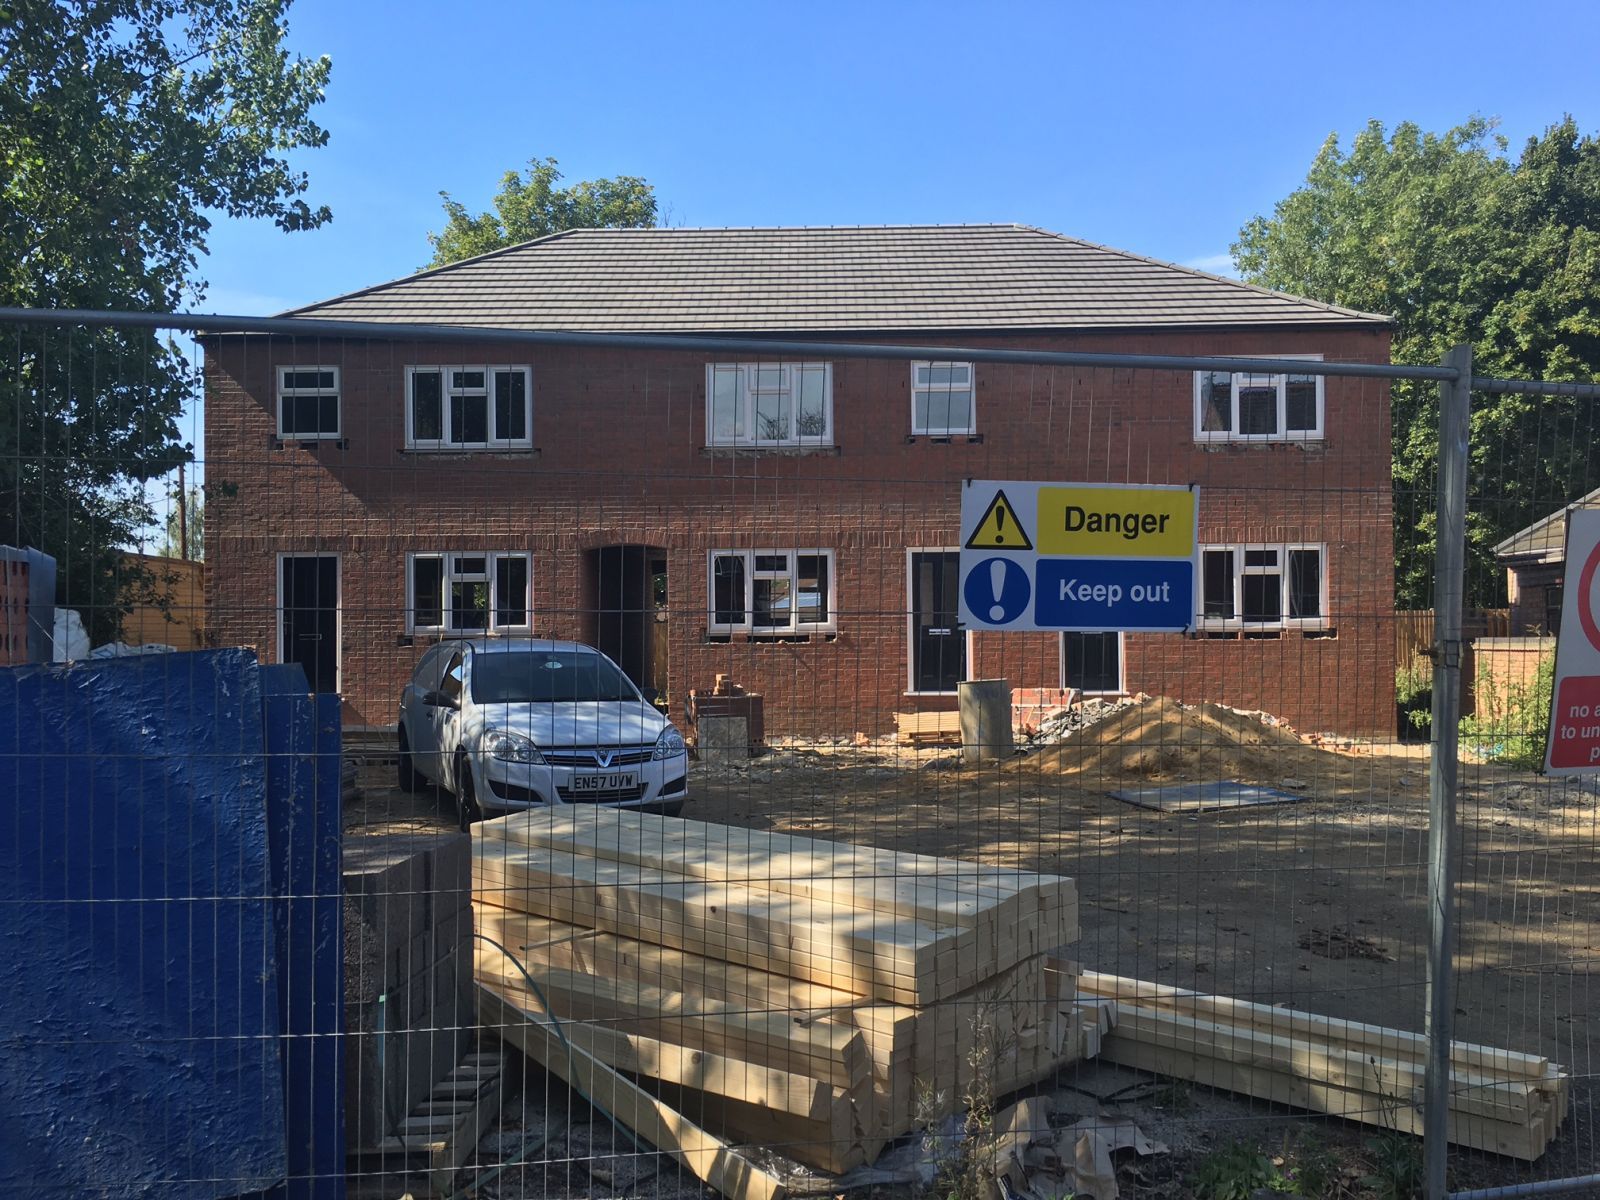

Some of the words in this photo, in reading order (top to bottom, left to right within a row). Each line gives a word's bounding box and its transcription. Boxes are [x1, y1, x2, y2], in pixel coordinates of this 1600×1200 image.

[1065, 506, 1170, 540] Danger
[1059, 579, 1122, 607] Keep
[1130, 581, 1170, 603] out
[1570, 705, 1590, 718] no
[1561, 725, 1576, 739] to
[575, 776, 606, 789] EN57
